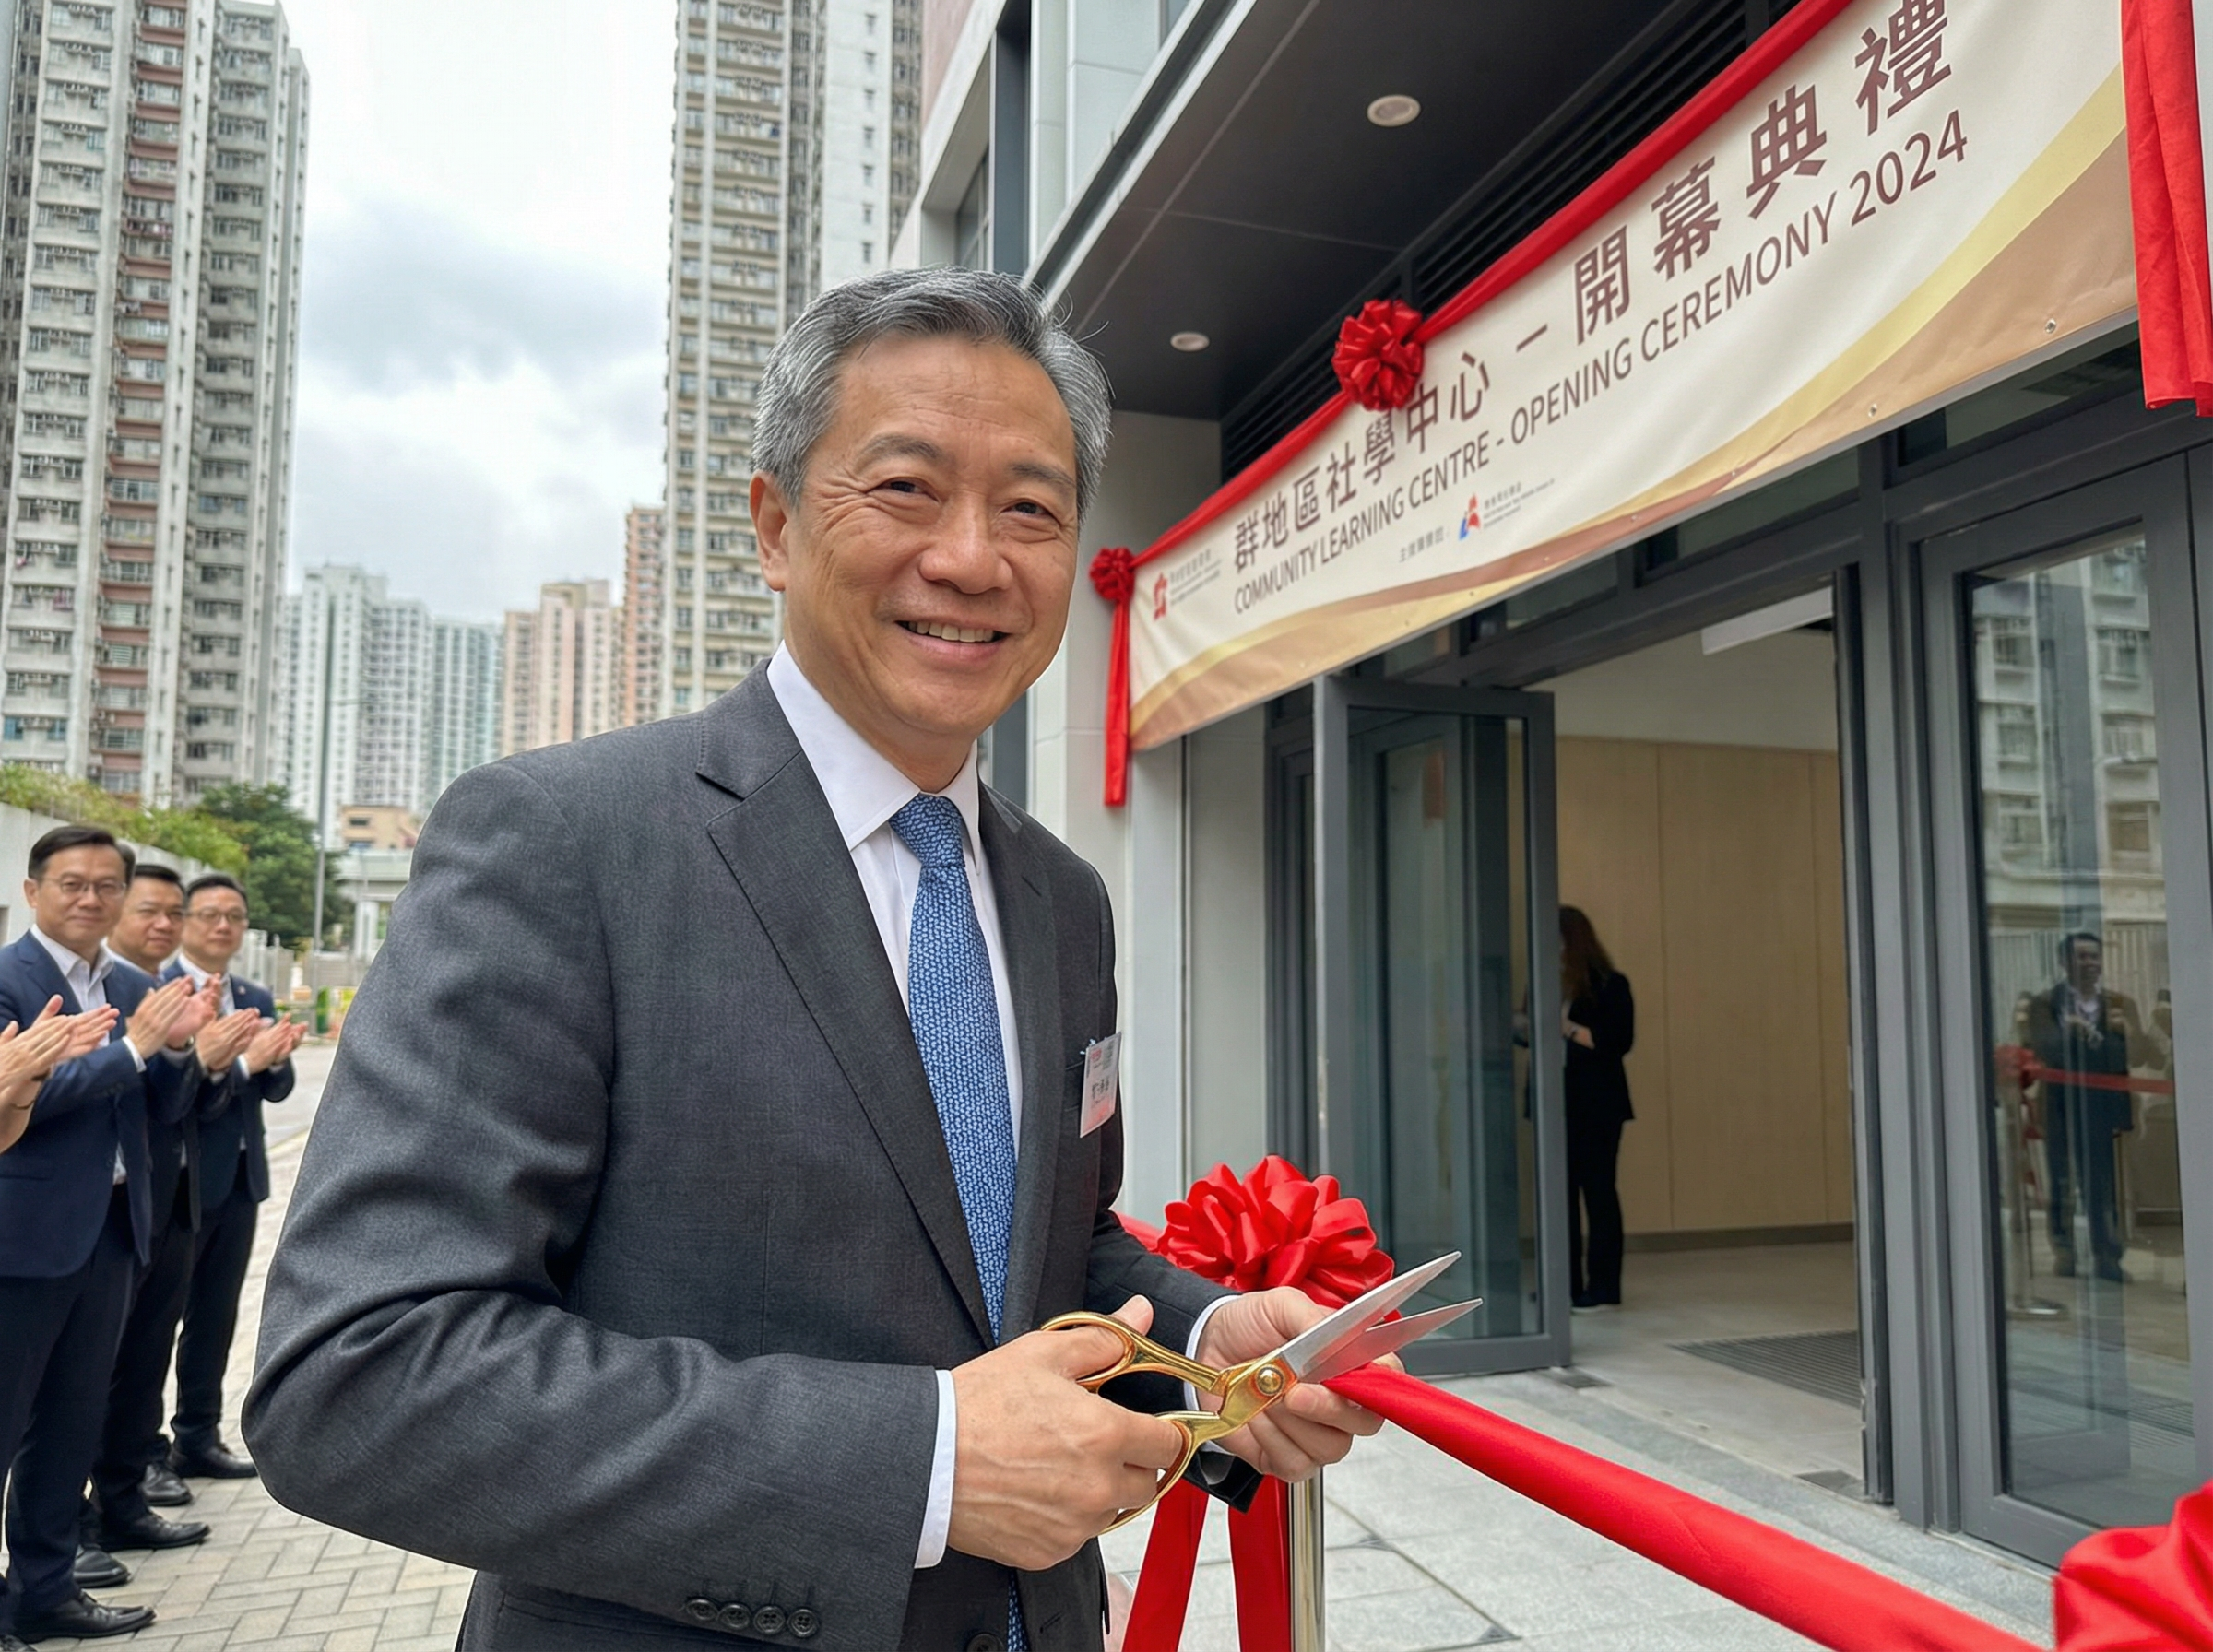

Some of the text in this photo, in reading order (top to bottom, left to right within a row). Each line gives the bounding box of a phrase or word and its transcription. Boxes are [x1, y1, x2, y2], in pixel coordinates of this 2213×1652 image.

[1235, 351, 1491, 573] 群地區社學中心
[1574, 0, 1952, 346] 開幕典禮
[1235, 539, 1319, 615] COMMUNITY
[1320, 487, 1404, 564] LEARNING
[1409, 430, 1489, 509] CENTRE
[1511, 337, 1631, 444] OPENING
[1641, 190, 1838, 362] CEREMONY
[1849, 109, 1968, 227] 2024
